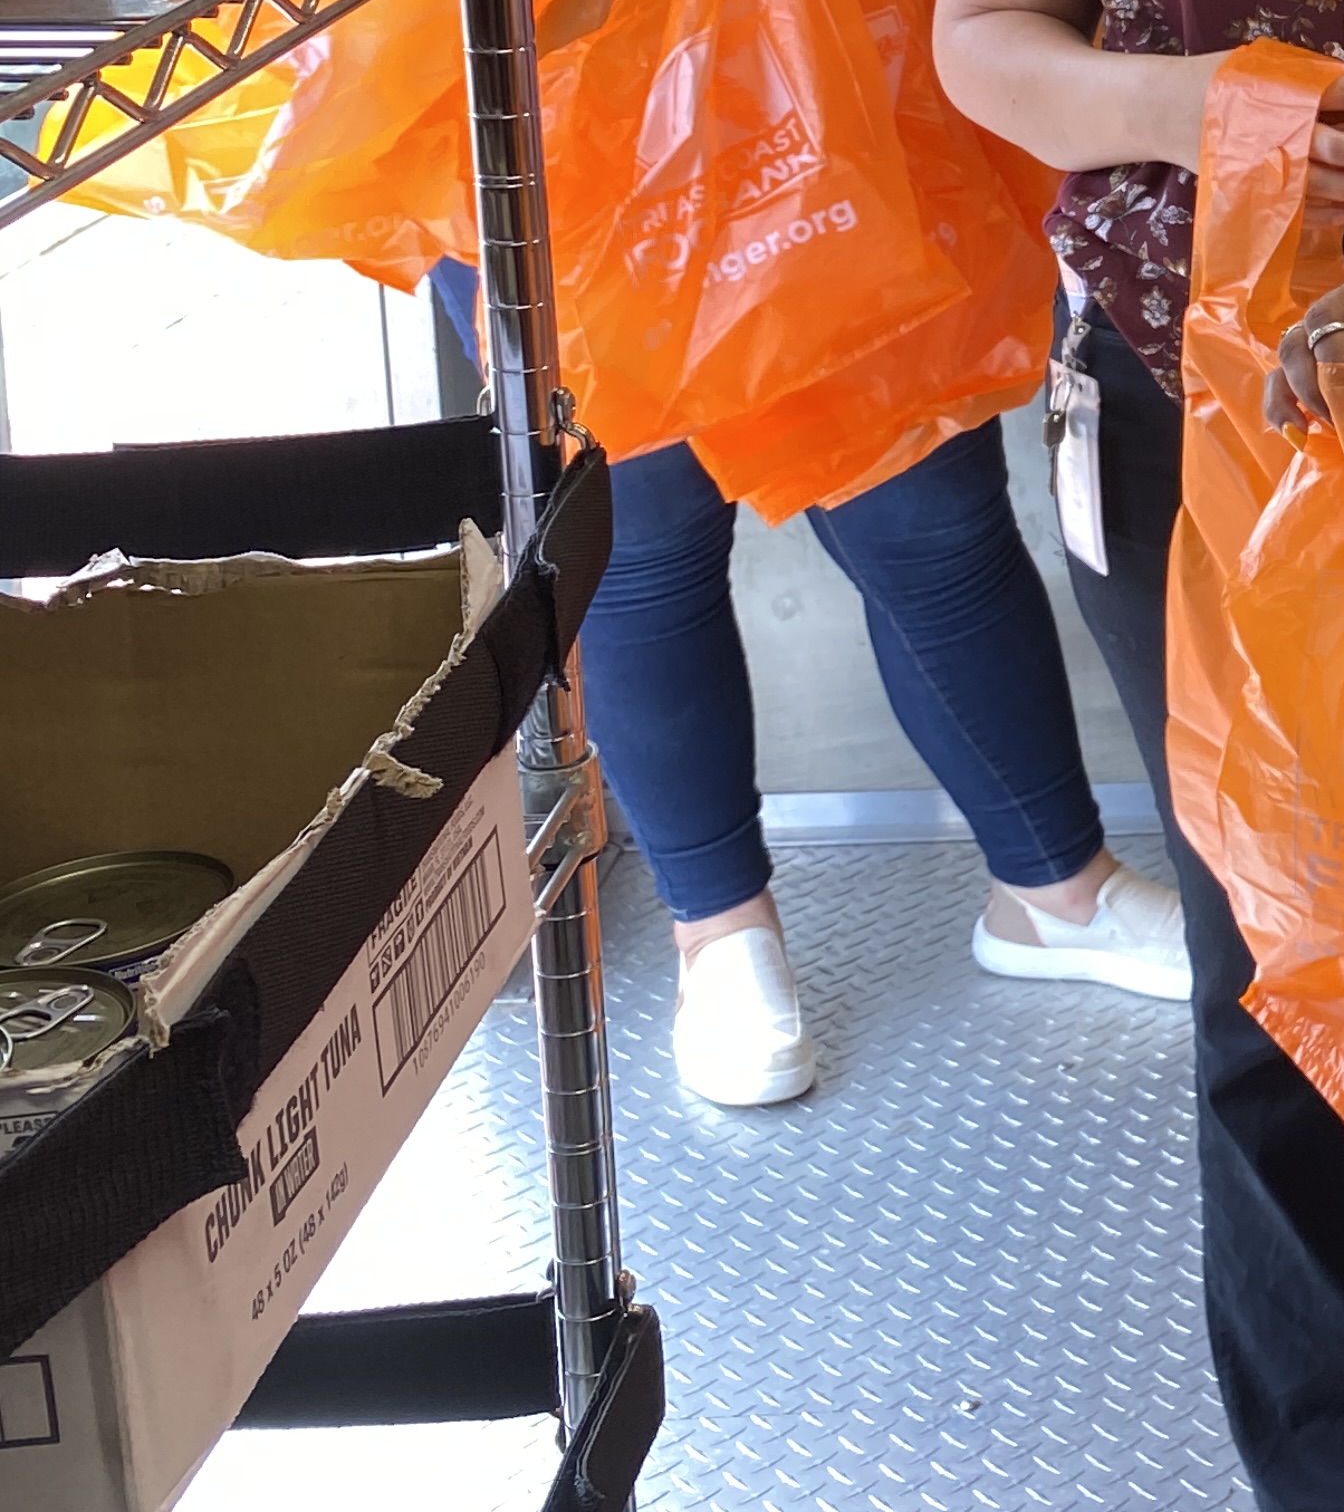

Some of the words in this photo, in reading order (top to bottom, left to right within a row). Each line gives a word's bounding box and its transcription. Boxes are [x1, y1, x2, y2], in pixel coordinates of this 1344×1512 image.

[266, 1064, 320, 1170] LIGHT
[320, 1002, 361, 1093] TUNA
[284, 1138, 316, 1198] WATER
[252, 1289, 265, 1320] 48
[266, 1280, 274, 1303] x
[274, 1263, 282, 1288] 5
[283, 1238, 298, 1273] OZ
[299, 1213, 316, 1255] (48
[318, 1205, 325, 1227] x
